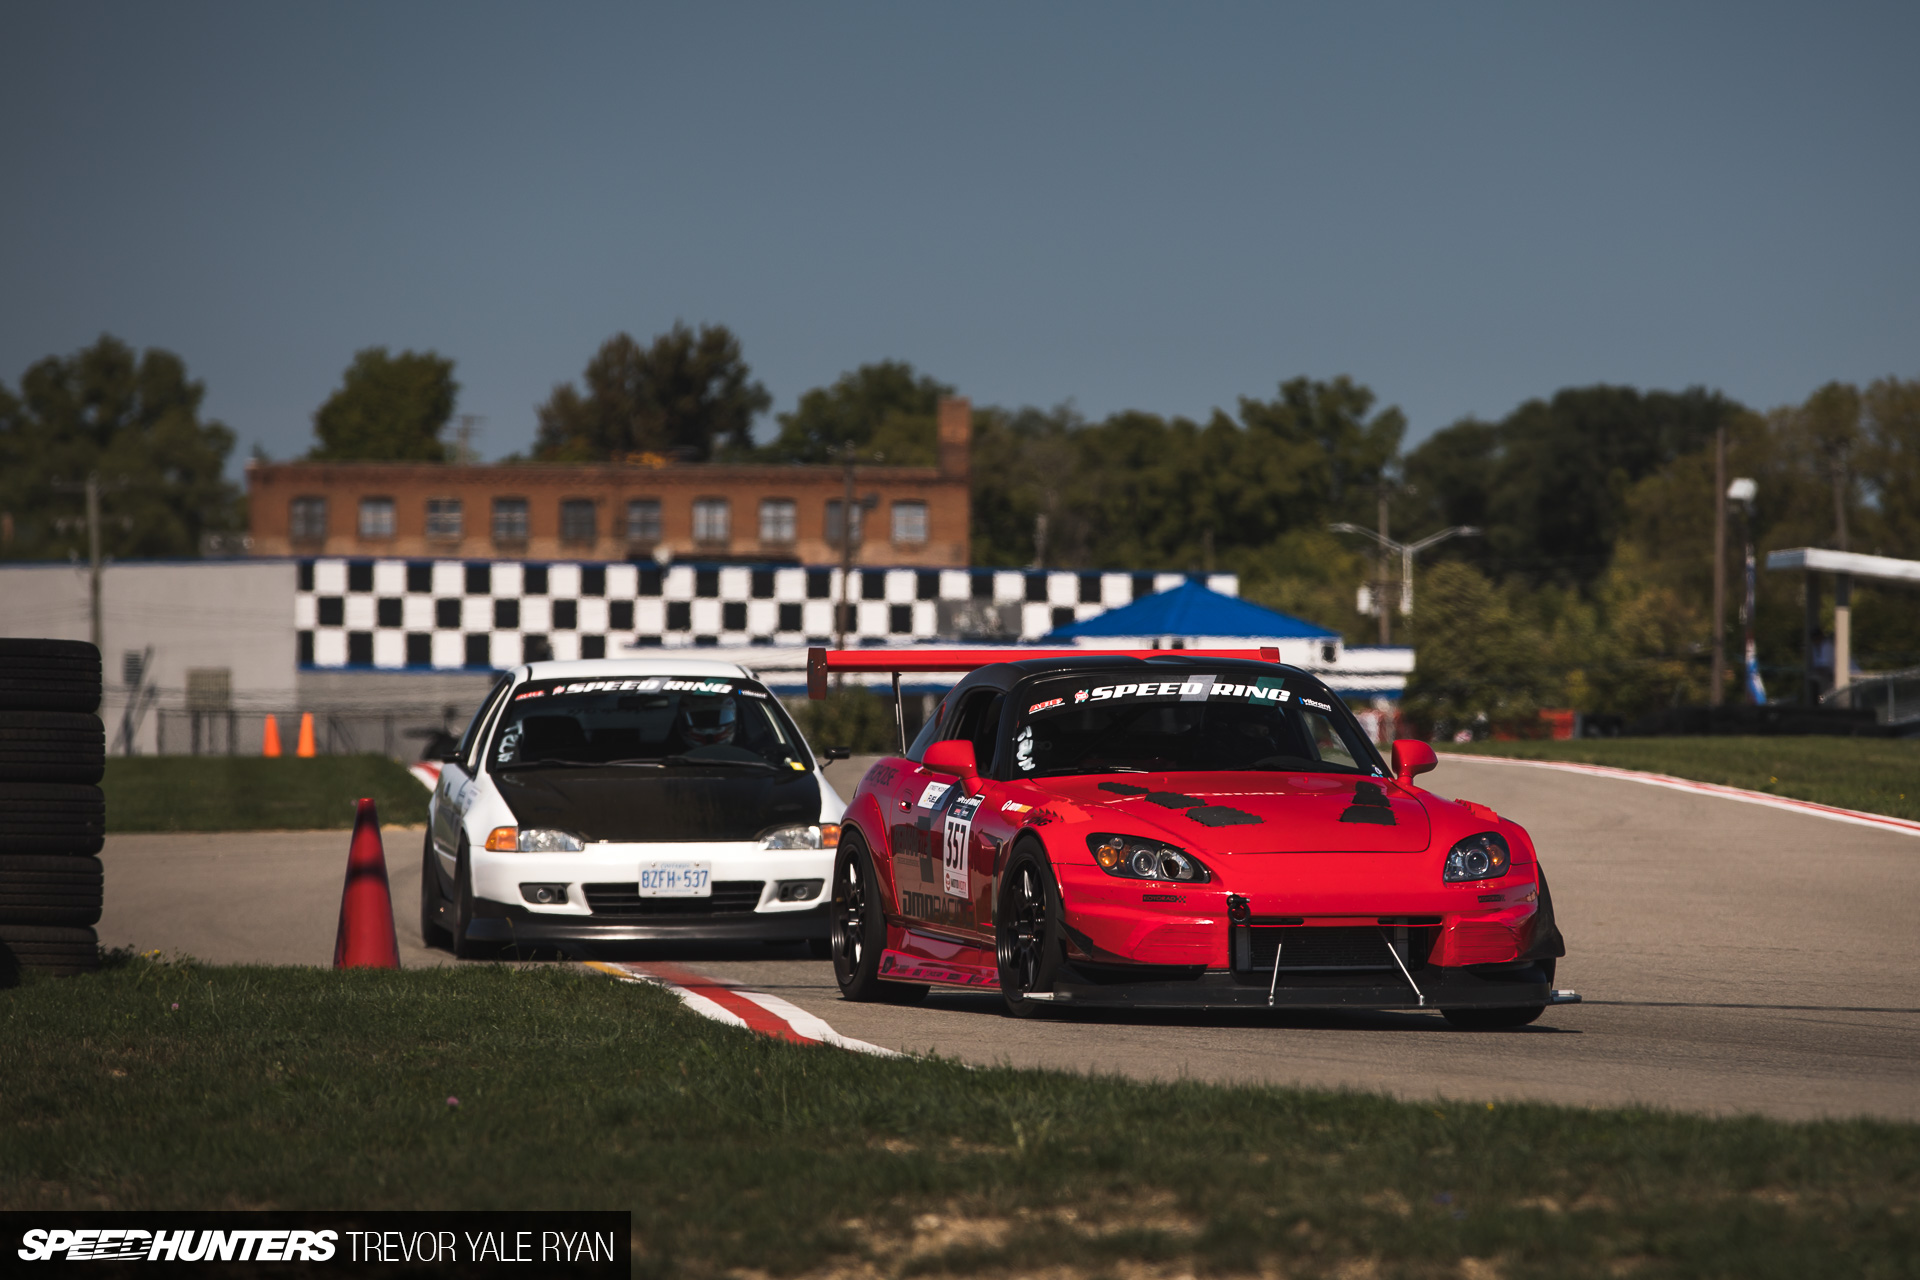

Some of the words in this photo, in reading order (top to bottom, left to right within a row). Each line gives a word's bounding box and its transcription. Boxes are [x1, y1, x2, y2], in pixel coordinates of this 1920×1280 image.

[565, 680, 660, 694] SPEED
[1089, 682, 1202, 702] SPEED
[1210, 683, 1291, 702] RING
[946, 823, 966, 870] 357
[683, 870, 708, 888] 537
